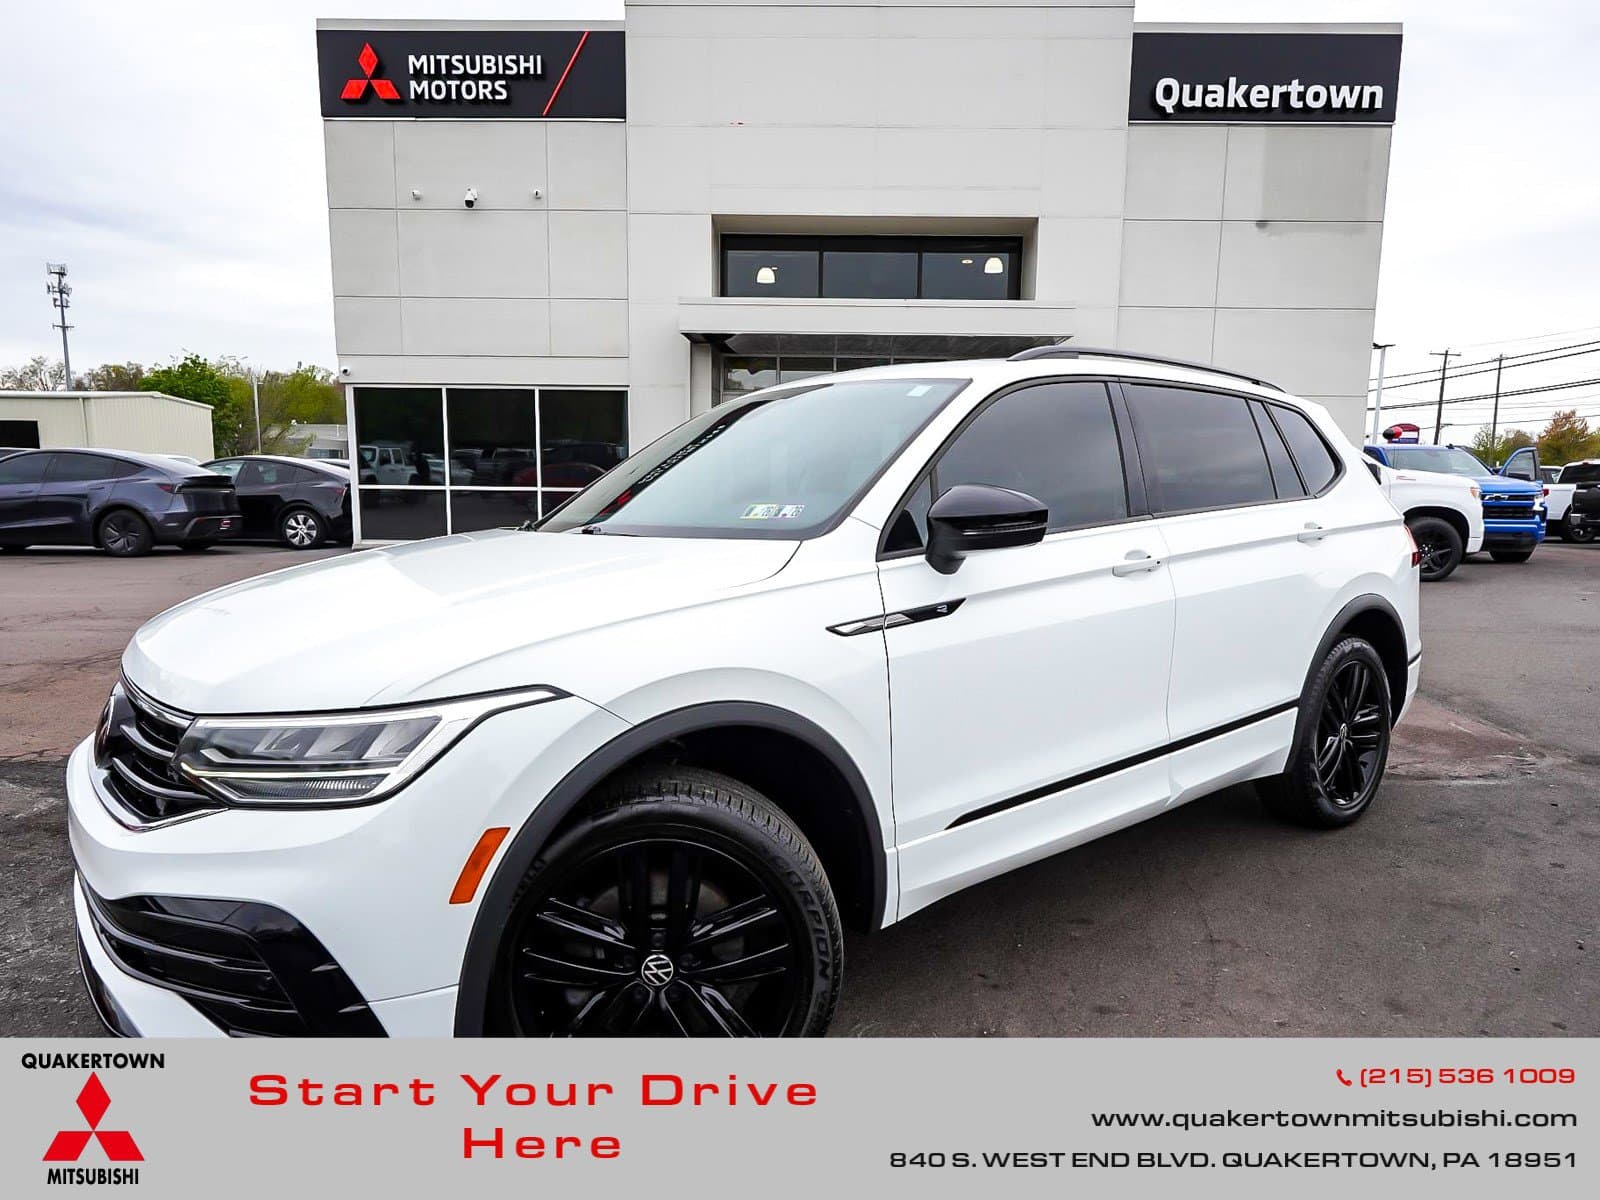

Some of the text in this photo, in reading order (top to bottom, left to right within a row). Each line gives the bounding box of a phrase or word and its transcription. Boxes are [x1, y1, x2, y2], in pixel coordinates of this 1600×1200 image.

[407, 54, 542, 75] MITSUBISHI
[409, 80, 508, 100] MOTORS
[1155, 76, 1384, 113] Quakertown
